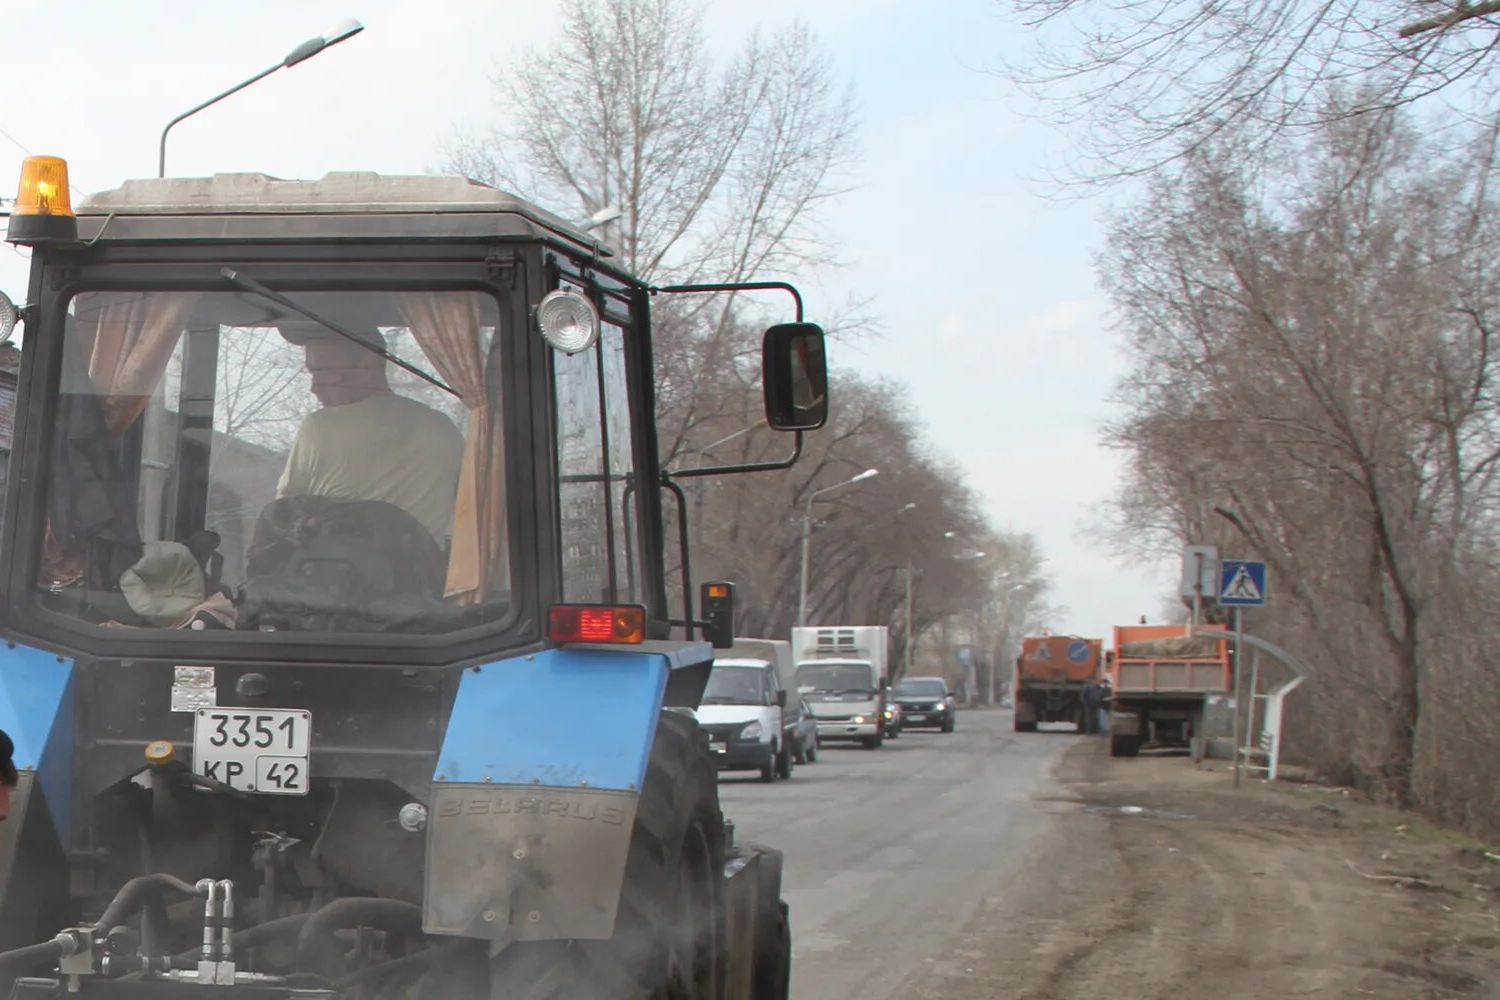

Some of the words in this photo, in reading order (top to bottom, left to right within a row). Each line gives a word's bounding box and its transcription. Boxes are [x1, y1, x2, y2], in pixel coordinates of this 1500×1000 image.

[209, 714, 295, 749] 3351
[266, 762, 299, 789] 42
[438, 798, 627, 825] BELARUS
